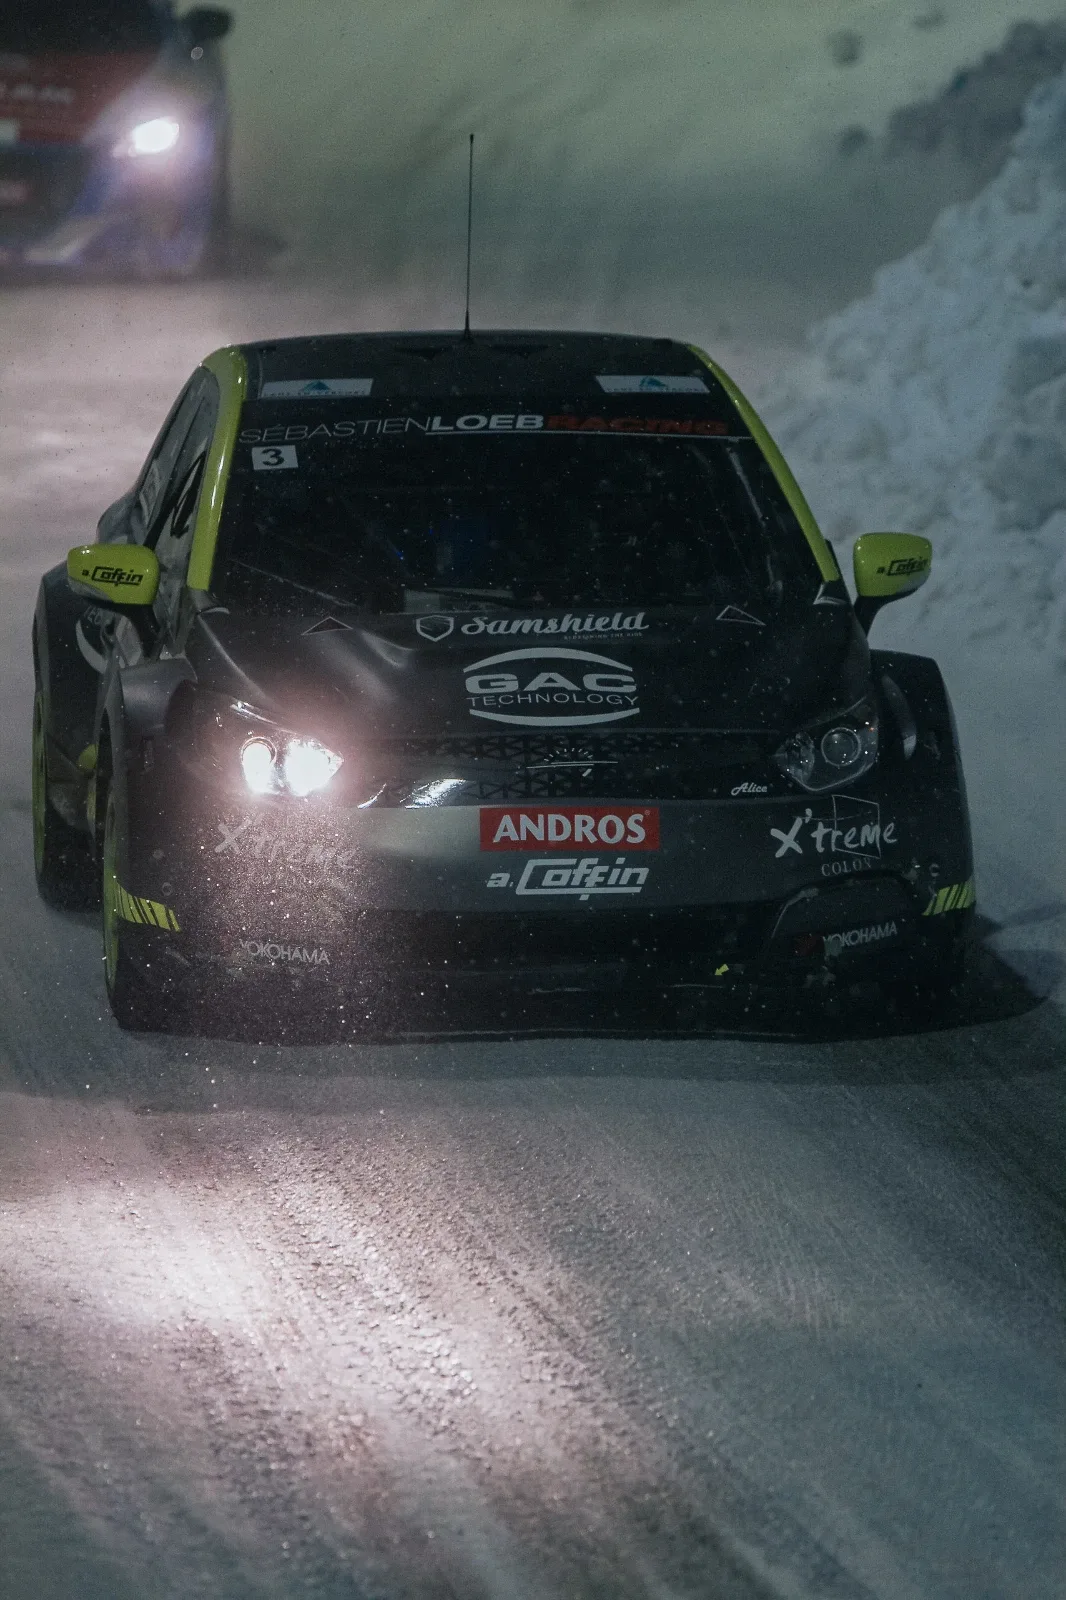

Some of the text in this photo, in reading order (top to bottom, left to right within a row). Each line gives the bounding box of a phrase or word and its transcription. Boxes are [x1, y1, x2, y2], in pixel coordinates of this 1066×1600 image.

[430, 413, 544, 431] LOEB
[546, 413, 729, 436] RACING
[262, 448, 284, 467] 3
[460, 611, 650, 635] Samshield
[465, 672, 637, 694] GAC
[466, 692, 639, 707] TECHNOLOGY
[731, 782, 768, 796] Alice
[492, 812, 647, 845] ANDROS
[822, 920, 898, 947] YOKOHAMA
[239, 938, 331, 965] YOKOHAMA
